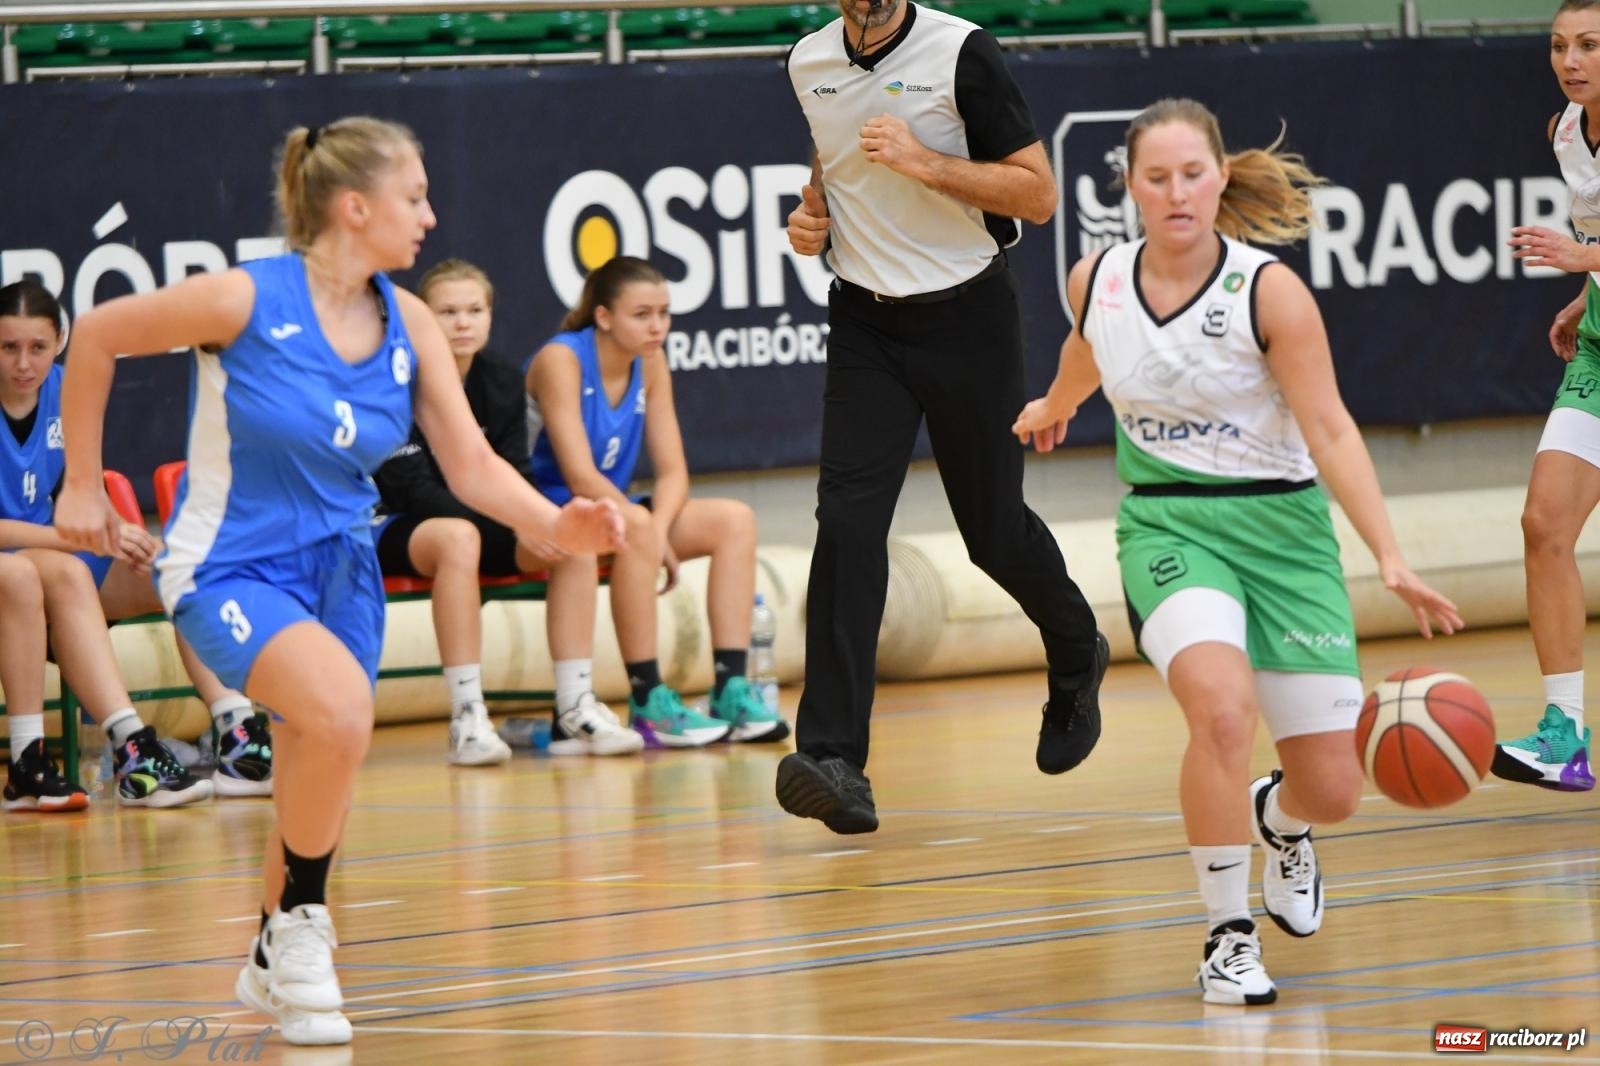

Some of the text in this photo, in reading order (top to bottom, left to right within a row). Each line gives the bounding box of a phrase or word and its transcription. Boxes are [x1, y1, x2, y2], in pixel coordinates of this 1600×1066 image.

[333, 400, 357, 448] 3
[23, 471, 36, 504] 4
[220, 599, 253, 645] 3
